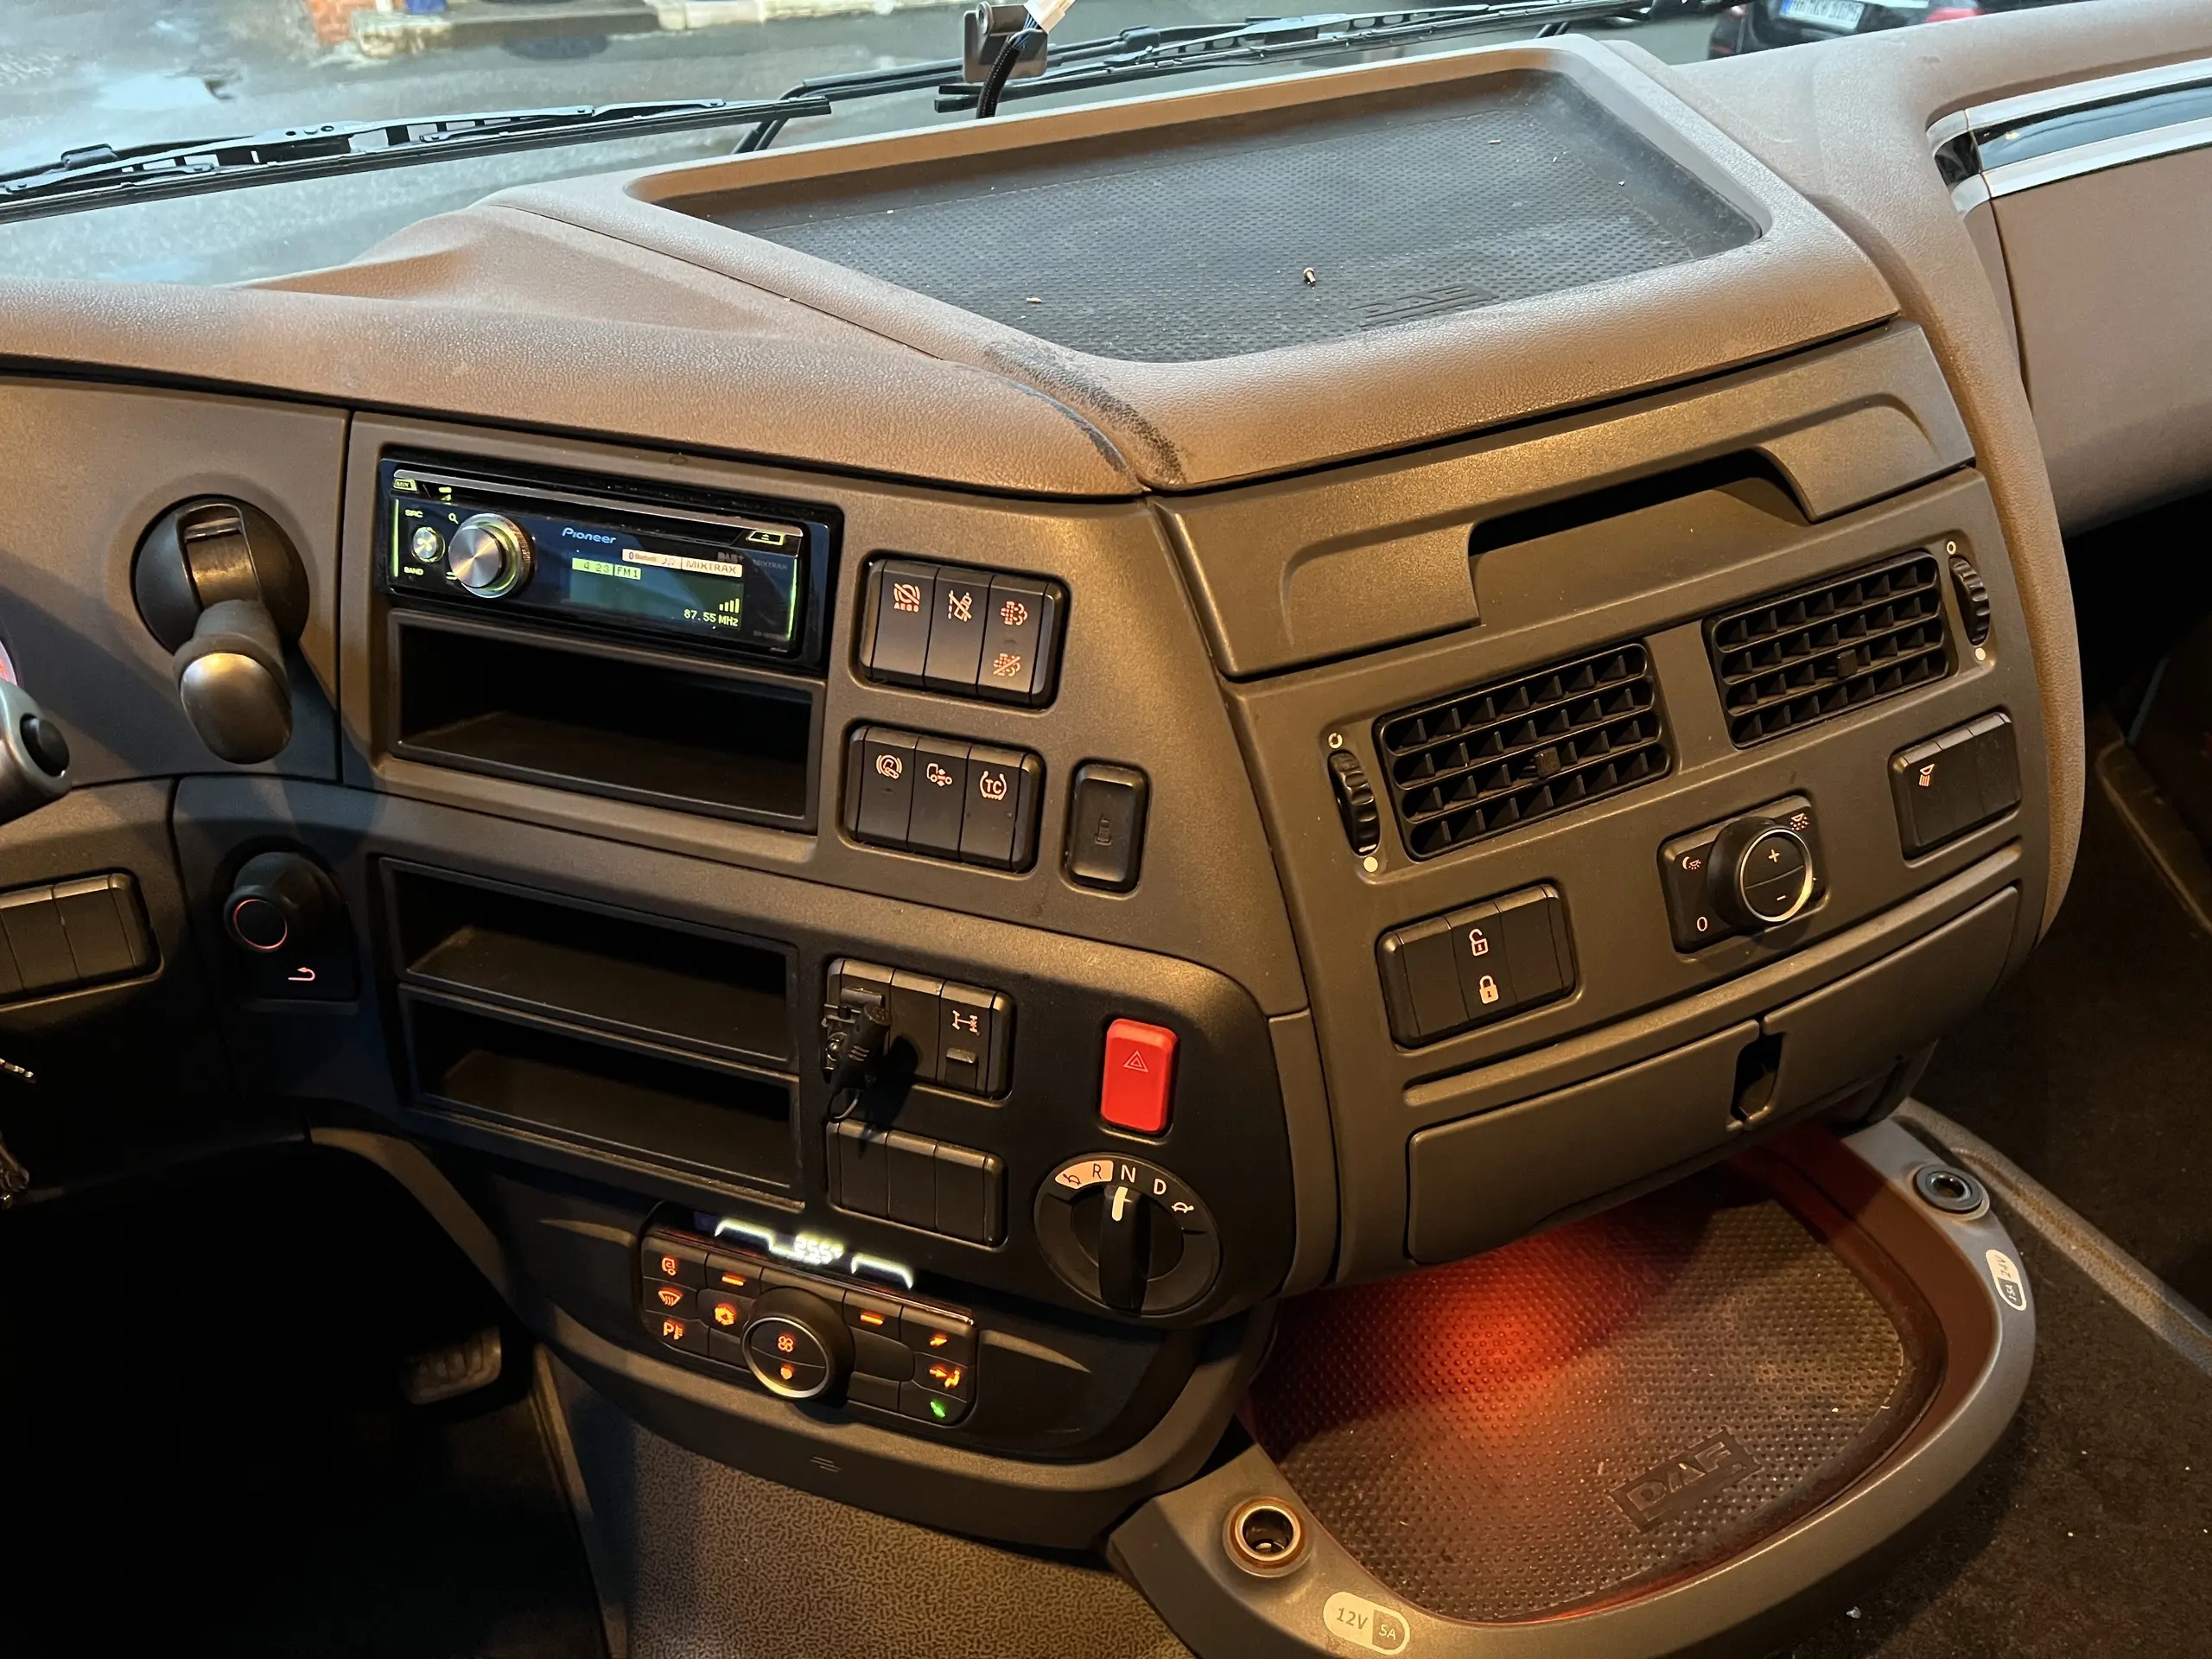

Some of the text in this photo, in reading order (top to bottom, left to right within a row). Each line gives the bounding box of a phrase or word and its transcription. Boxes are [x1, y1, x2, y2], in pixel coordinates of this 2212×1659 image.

[563, 527, 616, 543] Pioneer
[404, 566, 423, 575] BAND
[617, 566, 638, 578] FM1
[686, 560, 737, 574] MIXTRAX
[683, 608, 716, 623] 87.55
[985, 779, 1001, 794] TC
[1092, 1163, 1166, 1195] R N D
[1626, 1441, 1732, 1511] DAF
[1336, 1607, 1396, 1640] 12V 5A
